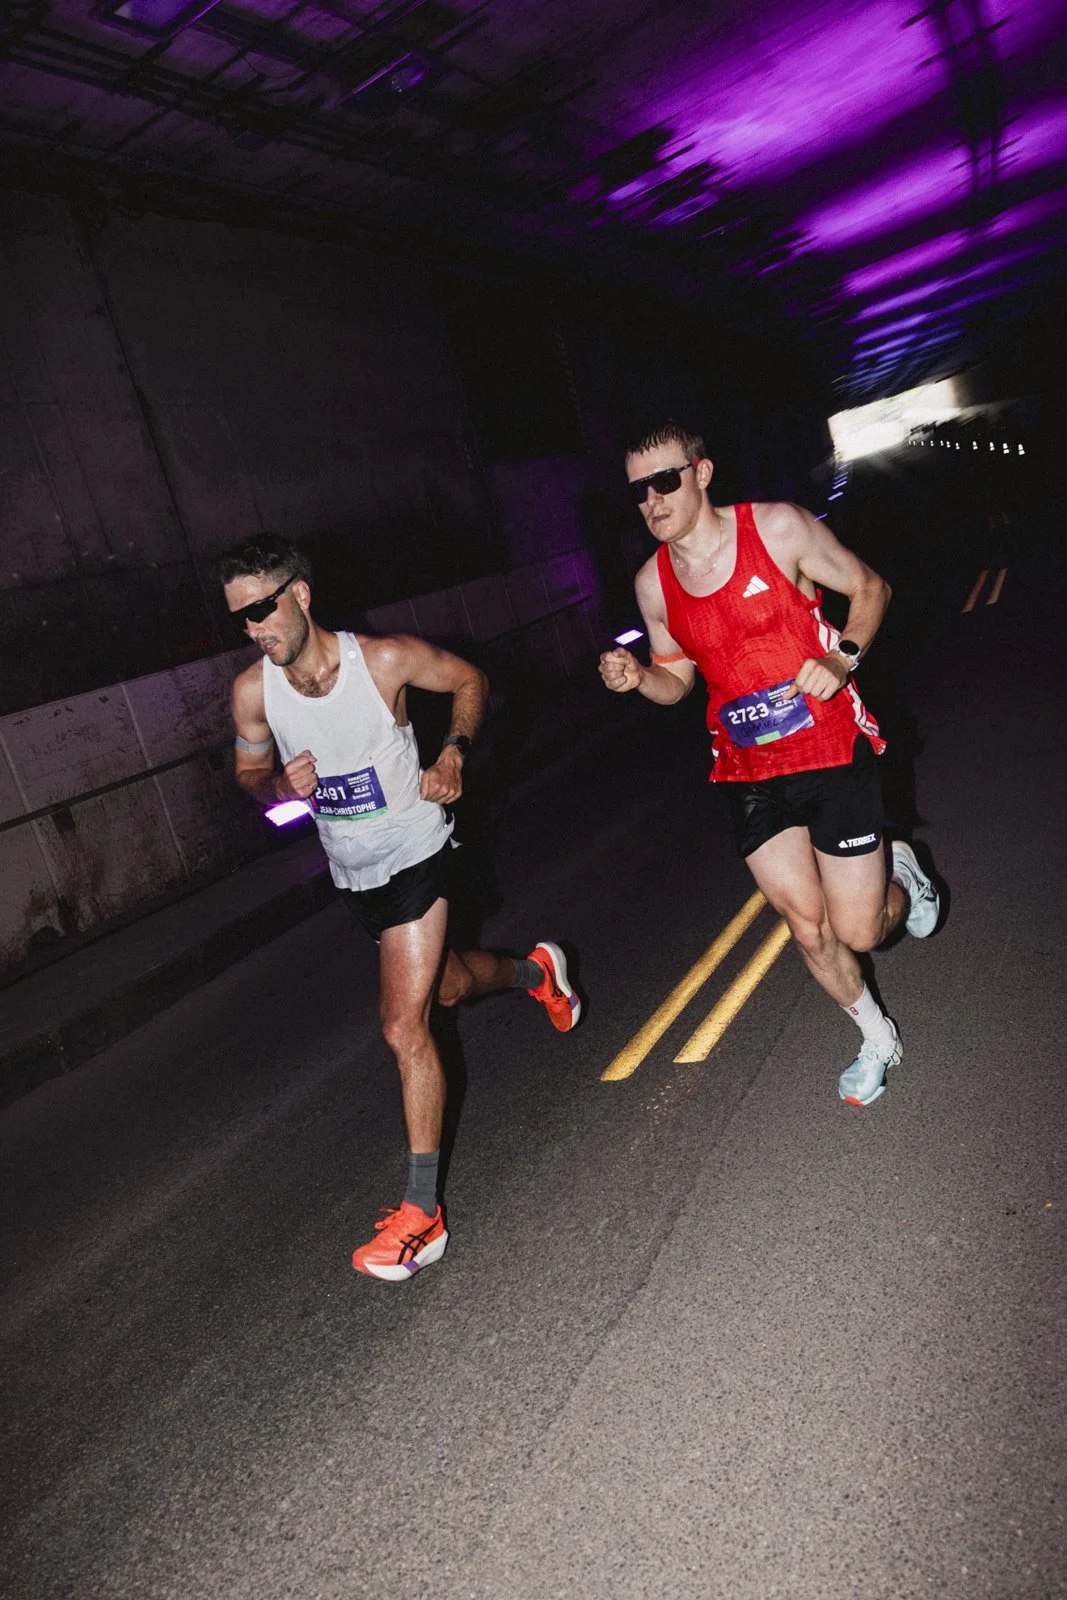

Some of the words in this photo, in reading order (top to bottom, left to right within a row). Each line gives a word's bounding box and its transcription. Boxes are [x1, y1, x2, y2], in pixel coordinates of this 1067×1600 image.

[728, 702, 770, 725] 2723
[315, 786, 346, 800] 2491
[320, 801, 376, 815] JEAN-CHRISTOPHE
[847, 833, 876, 847] TERREX
